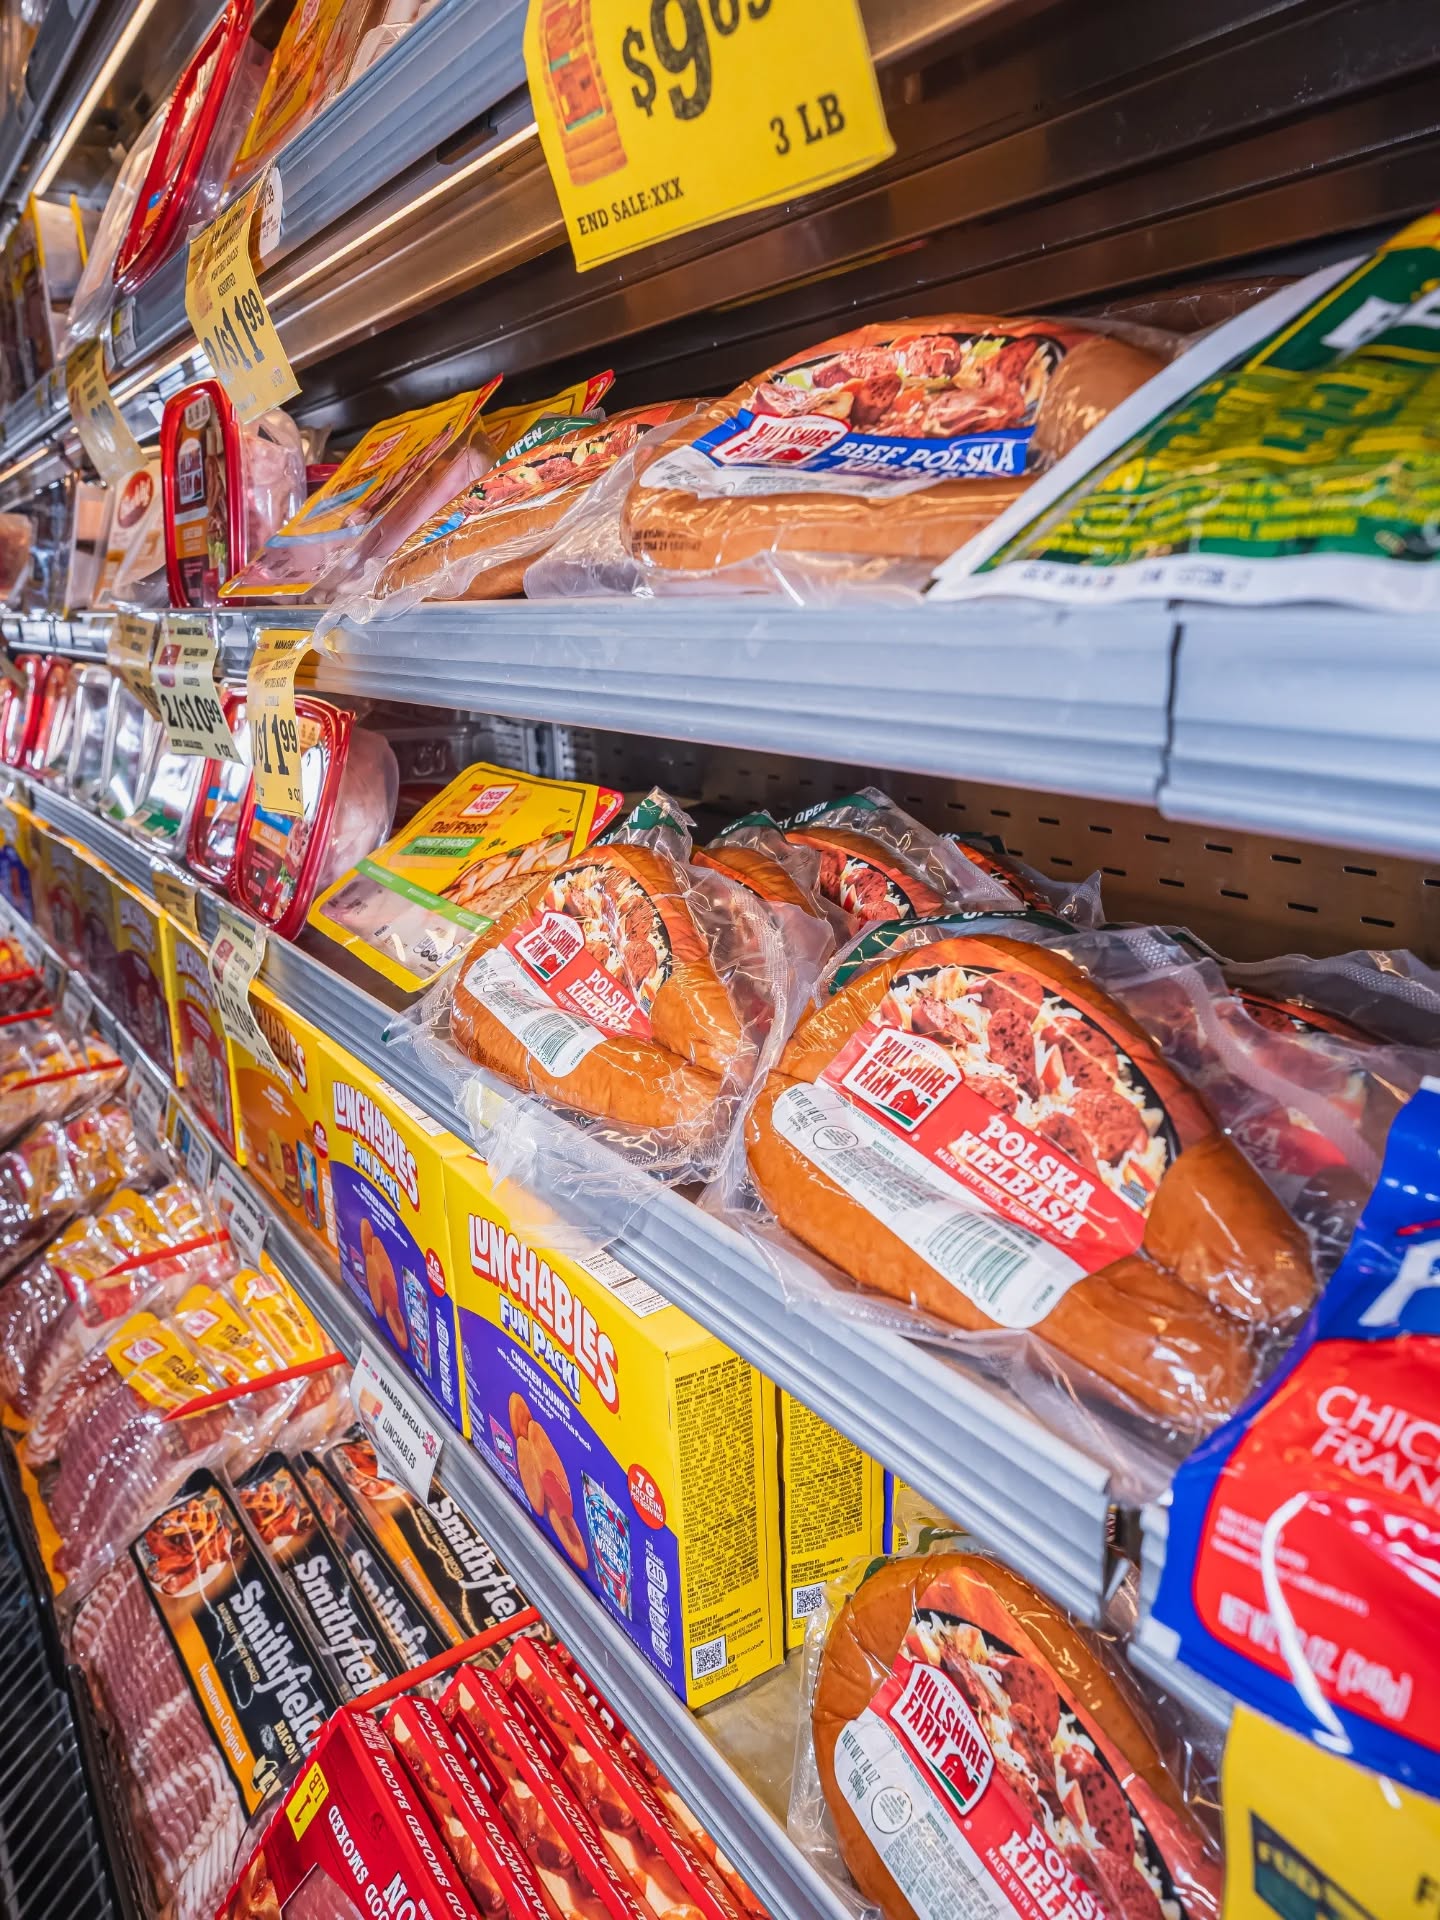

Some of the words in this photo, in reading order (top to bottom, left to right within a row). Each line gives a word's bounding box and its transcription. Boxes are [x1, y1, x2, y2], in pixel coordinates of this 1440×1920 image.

[770, 116, 791, 156] 3
[797, 92, 847, 146] LB
[576, 212, 609, 237] END
[611, 176, 685, 230] SALE:XXX
[830, 441, 907, 464] BEEF
[902, 439, 1017, 473] POLSKA
[794, 801, 828, 825] OPEN
[541, 917, 582, 961] HILLSHIRE
[585, 968, 635, 1023] POLSKA
[853, 1061, 901, 1101] FARM
[873, 1034, 956, 1099] HILLSHIRE
[333, 1080, 420, 1212] LUNCHABLES
[353, 1138, 372, 1174] FUN
[373, 1155, 401, 1212] PACK!
[934, 1147, 957, 1170] MADE
[956, 1165, 979, 1187] WITH
[979, 1114, 1096, 1212] POLSKA
[950, 1130, 1088, 1240] KIELBASA
[468, 1213, 619, 1414] LUNCHABLES
[499, 1293, 531, 1348] FUN
[532, 1319, 581, 1404] PACK!
[379, 1377, 402, 1410] MANAGER
[401, 1408, 423, 1440] SPECIAL
[511, 1349, 542, 1390] CHICKEN
[542, 1384, 571, 1419] DUNKS
[382, 1417, 417, 1470] LUNCHABLES
[631, 1484, 662, 1514] PROTEIN
[428, 1496, 530, 1623] Smithfie
[649, 1561, 664, 1583] 210
[217, 1602, 238, 1640] NATURALLY
[243, 1656, 260, 1683] SMOKED
[294, 1555, 389, 1696] Smithfiel
[474, 1669, 507, 1718] BACON
[529, 1640, 568, 1687] BACON
[198, 1662, 226, 1720] Hometown
[220, 1714, 247, 1764] Original
[273, 1719, 301, 1765] BACON
[413, 1699, 449, 1751] BACON
[566, 1688, 612, 1748] SMOKED
[839, 1731, 856, 1749] NET
[900, 1691, 948, 1759] FARM
[914, 1669, 990, 1777] HILLSHIRE
[374, 1755, 411, 1812] BACON
[507, 1719, 552, 1788] SMOKED
[847, 1745, 866, 1764] WT.
[857, 1759, 872, 1773] 14
[864, 1770, 880, 1785] OZ
[309, 1768, 326, 1806] LB.
[444, 1752, 490, 1819] SMOKED
[607, 1748, 682, 1848] HARDWOOD
[329, 1805, 369, 1886] SMOKED
[406, 1813, 451, 1889] SMOKED
[551, 1784, 622, 1883] HARDWOOD
[986, 1847, 1008, 1879] MADE
[1008, 1878, 1031, 1907] WITH
